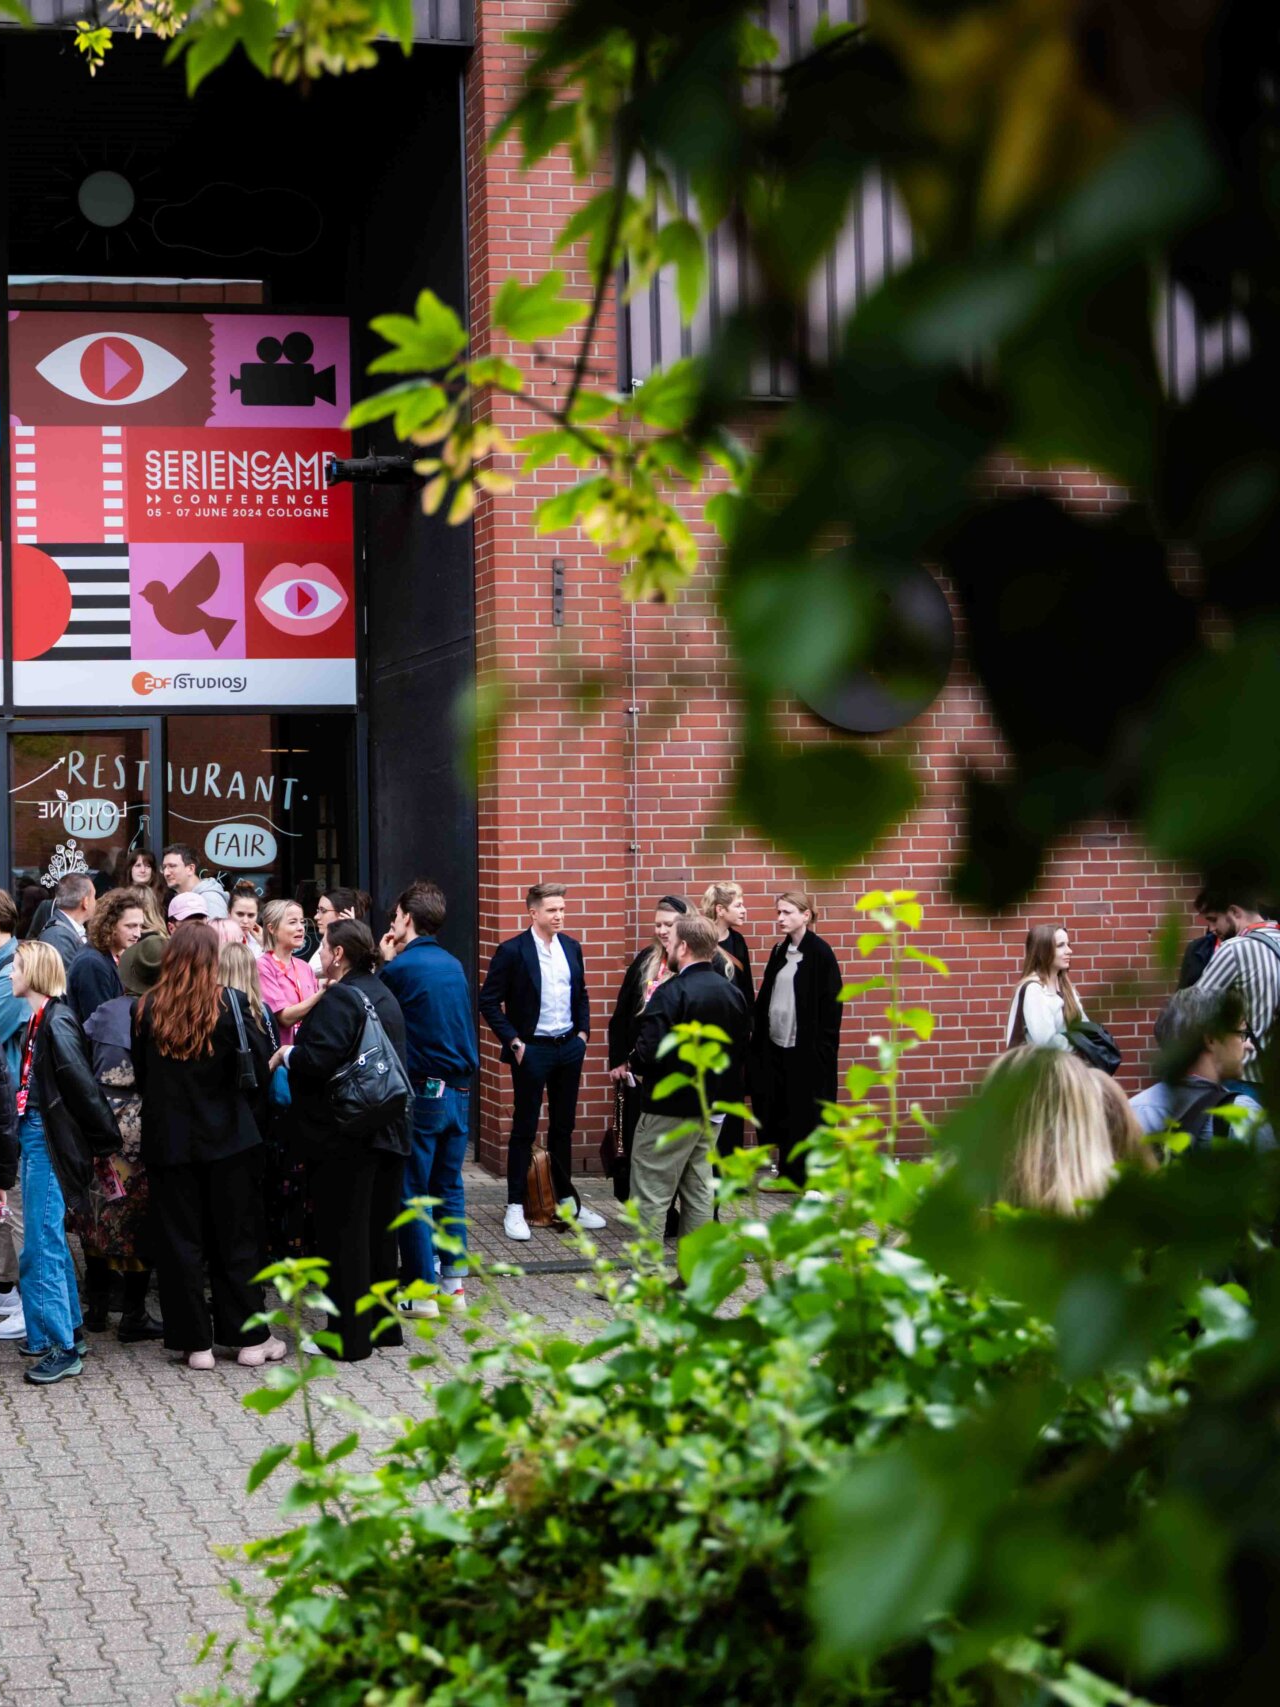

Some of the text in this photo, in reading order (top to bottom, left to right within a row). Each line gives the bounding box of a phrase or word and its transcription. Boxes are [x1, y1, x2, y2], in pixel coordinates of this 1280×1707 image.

[173, 494, 329, 505] CONFERENCE
[146, 508, 162, 518] 05
[176, 508, 190, 518] 07
[195, 508, 228, 518] JUNE
[232, 507, 263, 518] 2024
[266, 507, 329, 518] COLOGNE
[143, 676, 244, 690] ZDF STUDIOS
[71, 804, 115, 832] BIO
[214, 832, 266, 858] FAIR
